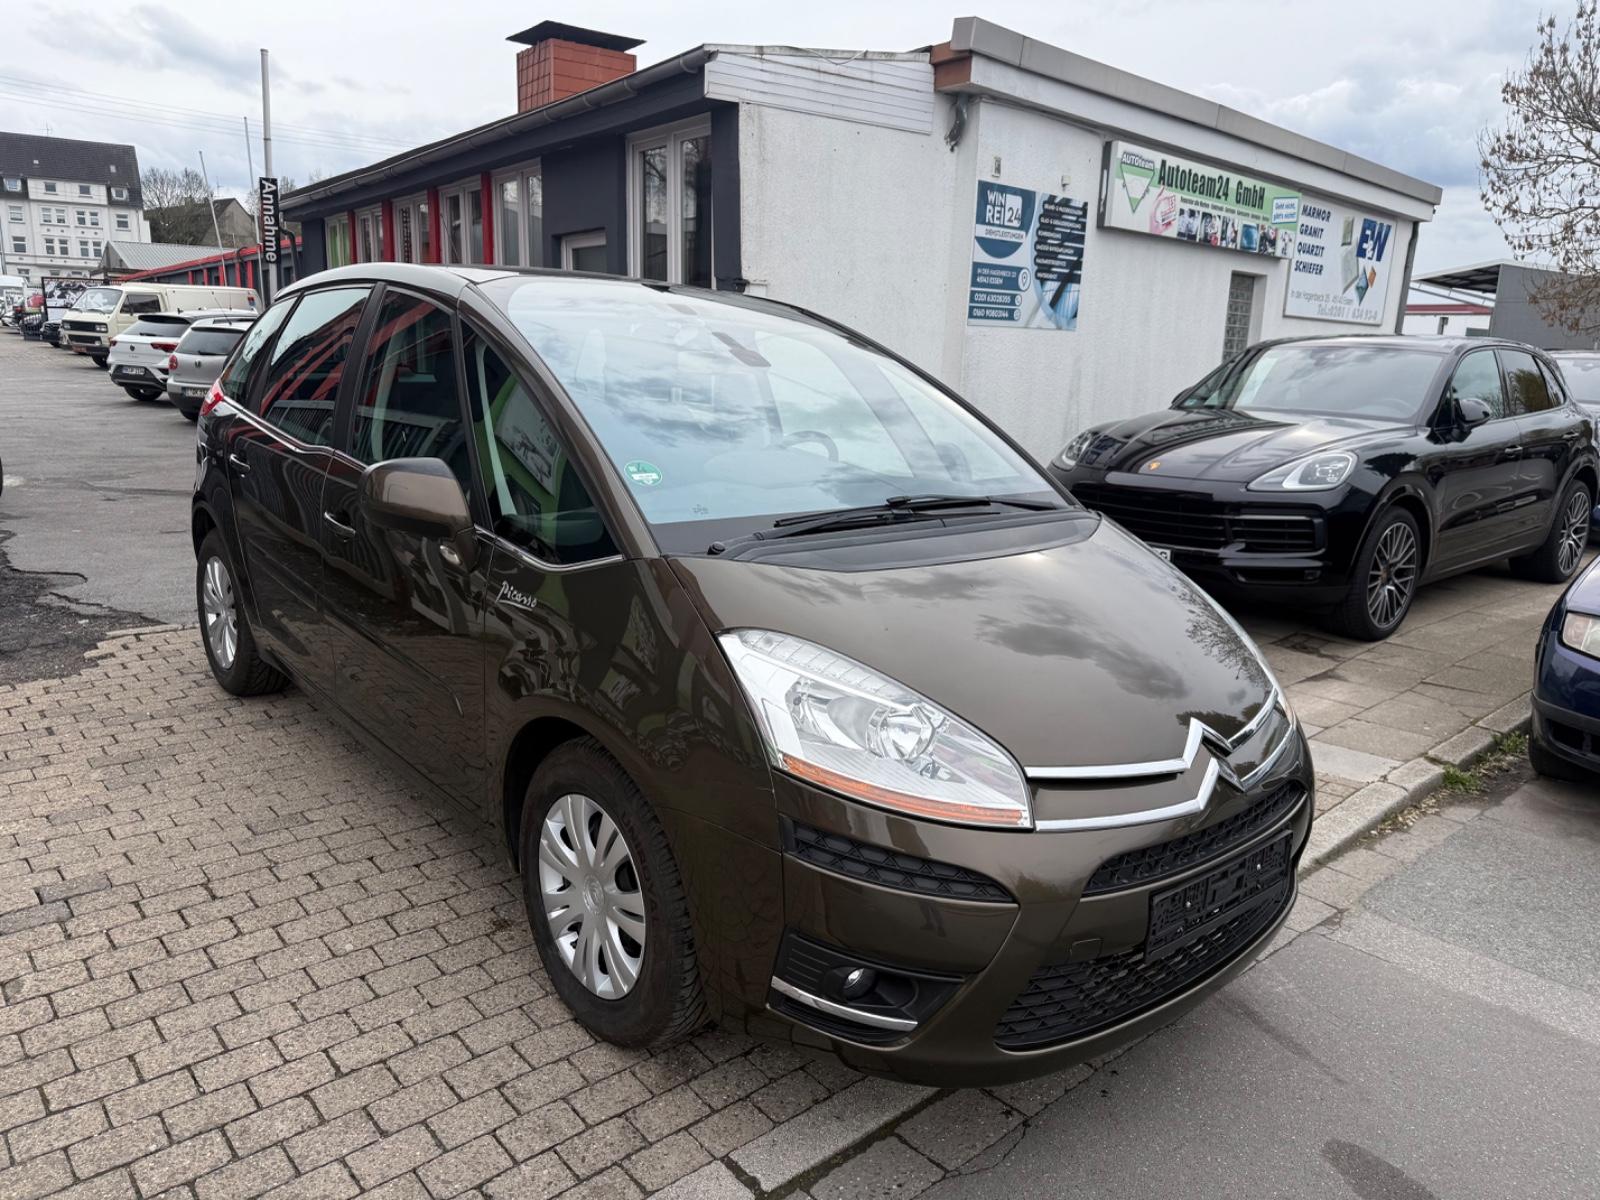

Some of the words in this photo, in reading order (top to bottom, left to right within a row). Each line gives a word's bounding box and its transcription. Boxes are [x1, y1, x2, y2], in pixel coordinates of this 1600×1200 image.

[1157, 159, 1230, 201] Autoteam24
[1235, 180, 1266, 210] GmbH
[987, 190, 1006, 207] WIN
[261, 180, 279, 263] Annahme
[985, 204, 1004, 226] REI
[1007, 207, 1021, 224] 24
[1301, 204, 1331, 222] MARMOR
[1299, 223, 1324, 239] GRANIT
[1297, 242, 1325, 257] QUARZIT
[1294, 260, 1324, 276] SCHIEFER
